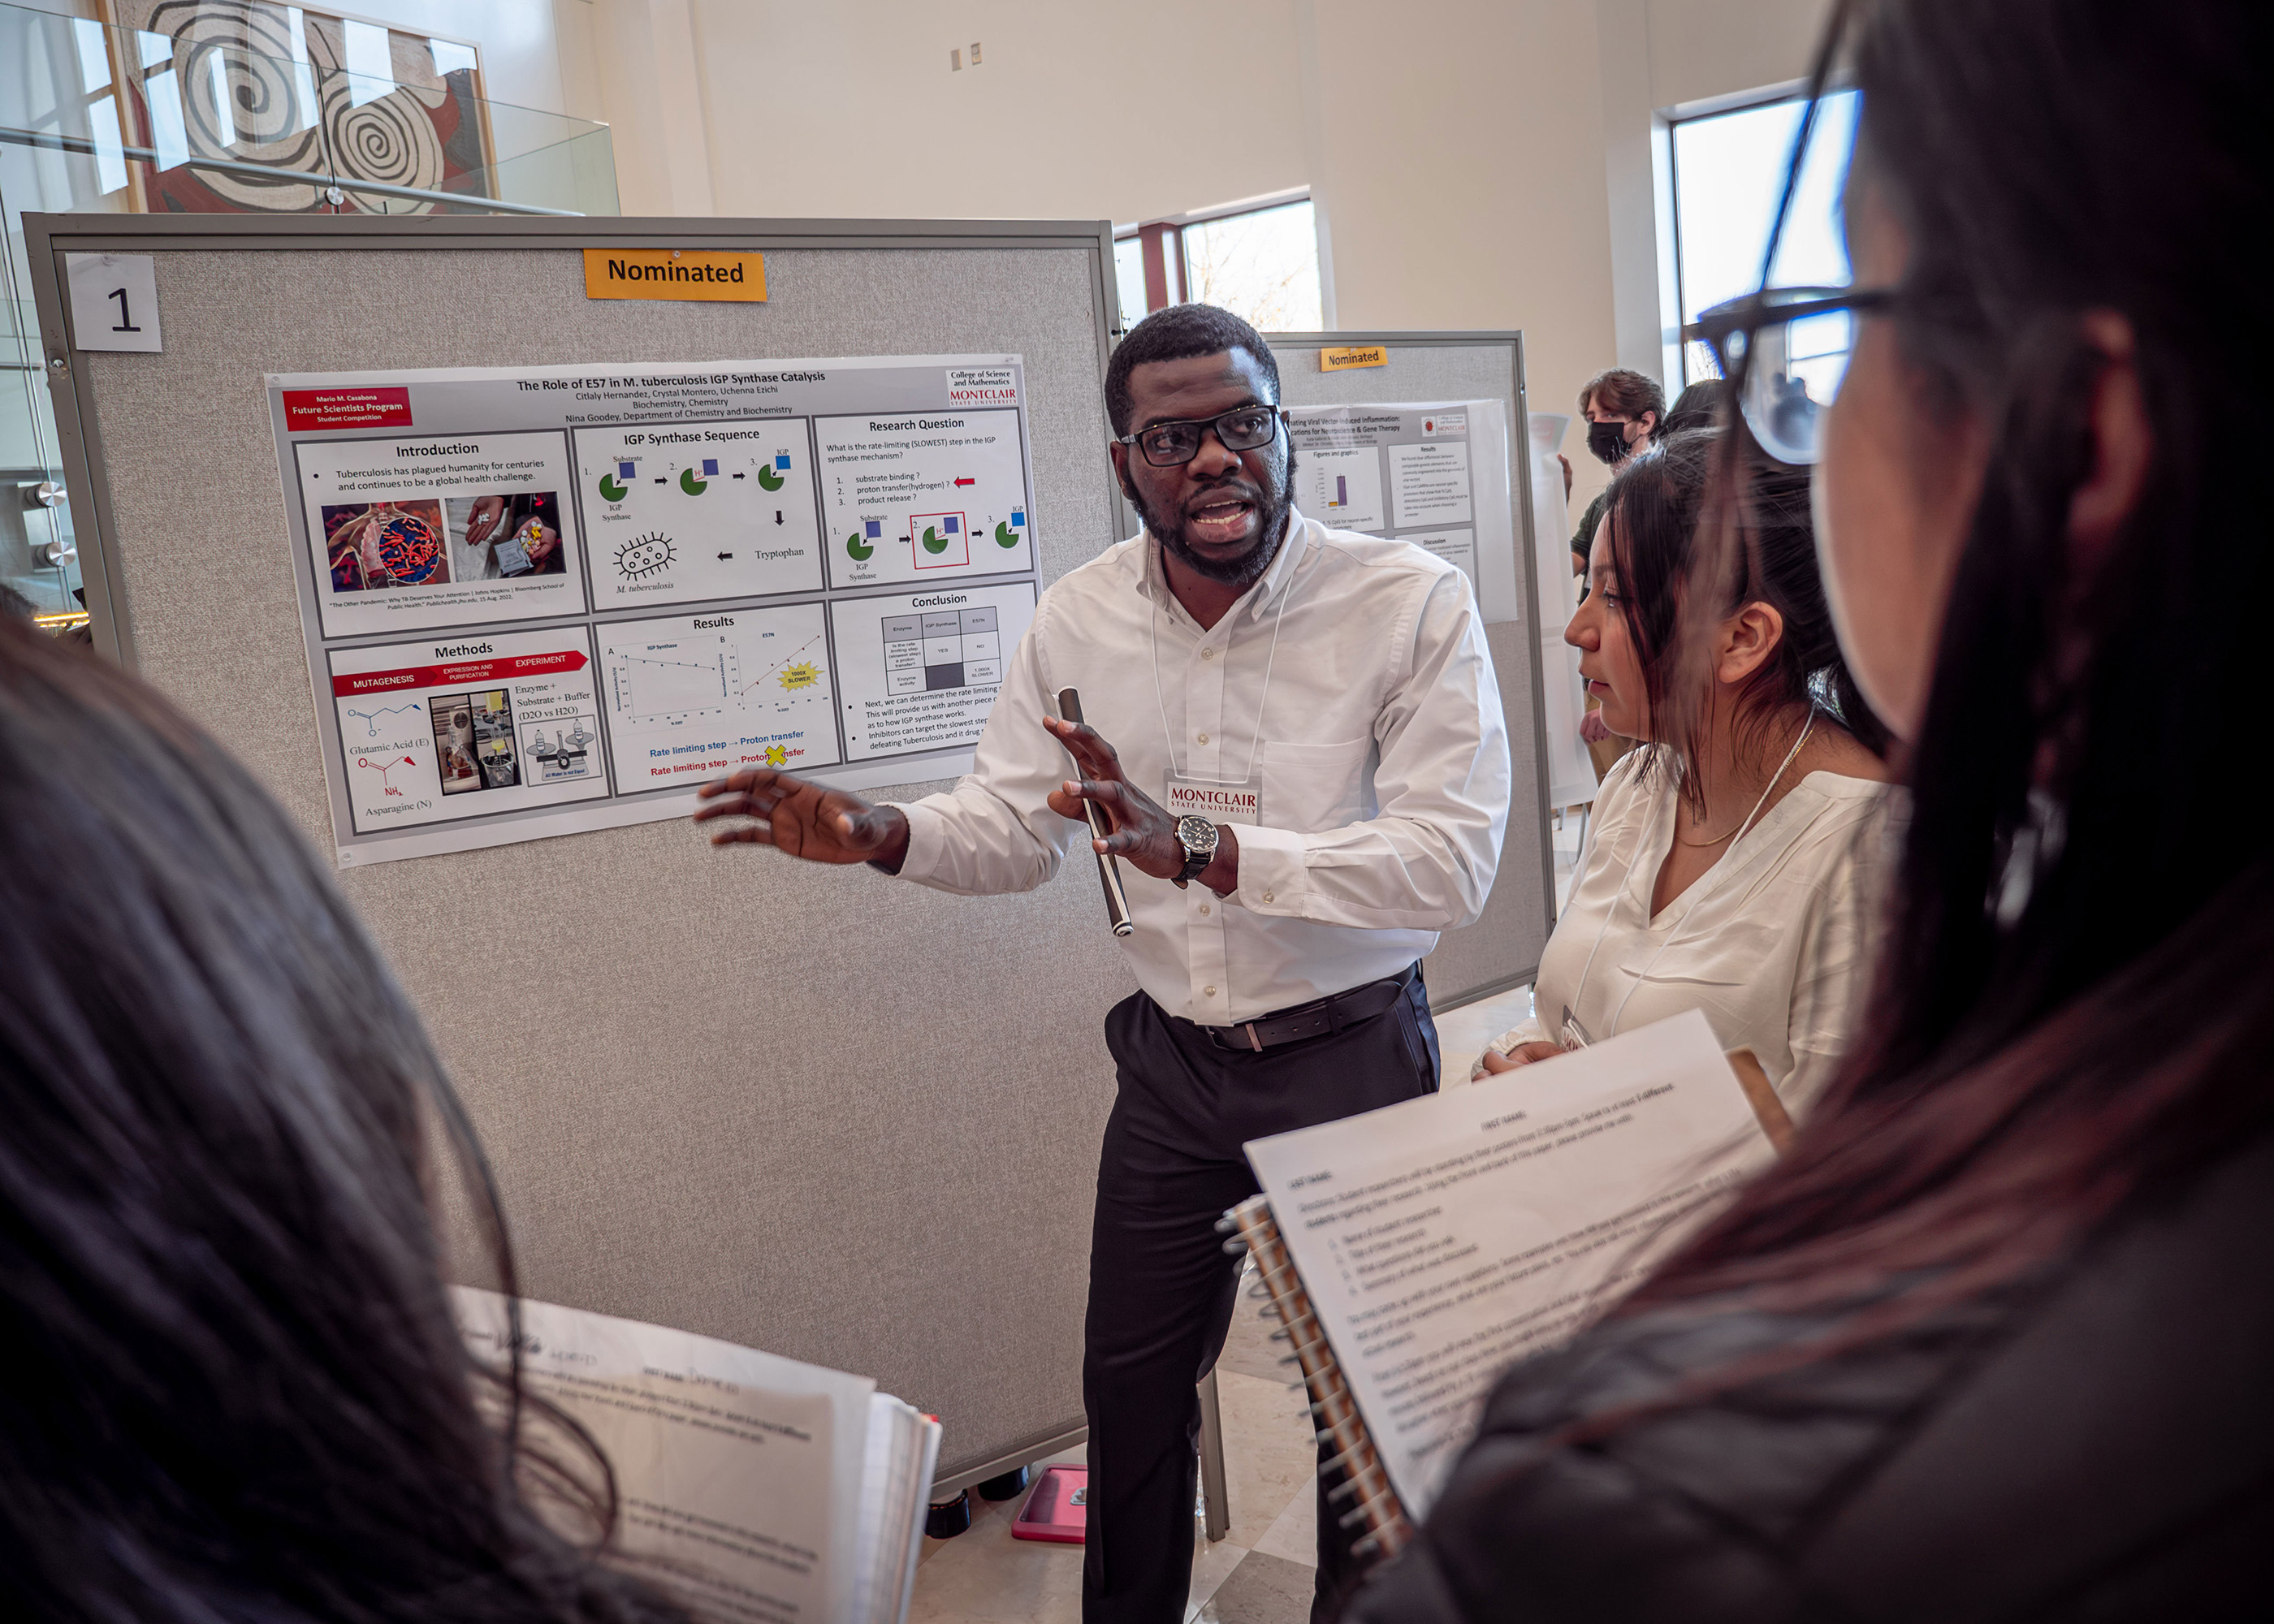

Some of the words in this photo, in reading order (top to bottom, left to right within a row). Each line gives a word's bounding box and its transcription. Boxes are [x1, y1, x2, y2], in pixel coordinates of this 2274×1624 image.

[608, 259, 744, 283] Nominated
[108, 287, 141, 332] 1
[1329, 350, 1379, 365] Nominated
[517, 380, 539, 391] The
[542, 379, 568, 390] Role
[571, 378, 582, 389] of
[586, 378, 606, 388] E57
[609, 378, 620, 387] in
[622, 378, 638, 387] M.
[641, 375, 708, 387] tuberculosis
[710, 374, 728, 384] IGP
[731, 373, 778, 385] Synthase
[780, 371, 825, 383] Catalysis
[950, 370, 976, 380] College
[953, 378, 966, 387] and
[968, 378, 1009, 386] Mathematics
[575, 391, 601, 401] Citlaly
[603, 390, 651, 400] Hernandez,
[651, 388, 680, 399] Crystal
[681, 388, 719, 397] Montero,
[720, 387, 754, 395] Uchenna
[756, 385, 778, 394] Ezichi
[950, 388, 1016, 400] MONTCLAIR
[292, 406, 322, 414] Future
[323, 404, 365, 413] Scientists
[365, 403, 403, 412] Program
[632, 400, 687, 410] Biochemistry,
[688, 398, 728, 407] Chemistry
[343, 413, 382, 421] Competition
[565, 414, 585, 422] Nina
[586, 412, 621, 423] Goodey,
[623, 411, 672, 421] Department
[674, 409, 682, 417] of
[684, 409, 724, 417] Chemistry
[726, 408, 741, 416] and
[742, 406, 792, 415] Biochemistry
[869, 419, 916, 432] Research
[919, 417, 965, 430] Question
[624, 434, 645, 445] IGP
[648, 431, 702, 446] Synthase
[704, 430, 759, 443] Sequence
[826, 443, 846, 451] What
[854, 443, 867, 451] the
[867, 441, 910, 450] rate-limiting
[910, 438, 948, 449] (SLOWEST)
[949, 438, 963, 447] step
[396, 443, 479, 457] Introduction
[827, 454, 858, 464] synthase
[860, 451, 903, 460] mechanism?
[335, 468, 392, 478] Tuberculosis
[393, 467, 409, 475] has
[411, 464, 447, 476] plagued
[447, 463, 489, 472] humanity
[491, 461, 504, 469] for
[505, 460, 545, 469] centuries
[338, 482, 356, 490] and
[357, 481, 401, 490] continues
[403, 479, 413, 487] to
[414, 477, 426, 486] be
[435, 475, 462, 487] global
[463, 473, 491, 483] health
[493, 473, 536, 482] challenge.
[855, 474, 888, 483] substrate
[888, 473, 914, 481] binding
[856, 486, 880, 495] proton
[881, 481, 945, 492] transfer(hydrogen)
[858, 496, 885, 506] product
[886, 495, 911, 503] release
[754, 547, 804, 560] Tryptophan
[911, 594, 967, 607] Conclusion
[693, 616, 734, 629] Results
[434, 642, 493, 658] Methods
[515, 654, 566, 667] EXPERIMENT
[352, 675, 414, 689] MUTAGENESIS
[515, 685, 548, 694] Enzyme
[517, 697, 555, 706] Substrate
[564, 691, 590, 702] Buffer
[864, 700, 884, 709] Next,
[910, 693, 945, 702] determine
[972, 686, 997, 694] limiting
[518, 710, 543, 721] (D2O
[555, 706, 578, 716] H2O)
[866, 710, 880, 719] This
[881, 708, 893, 716] will
[894, 705, 920, 716] provide
[930, 702, 946, 710] with
[947, 699, 973, 708] another
[974, 697, 991, 706] piece
[901, 716, 914, 724] IGP
[914, 714, 944, 723] synthase
[945, 710, 966, 718] works.
[868, 729, 901, 739] Inhibitors
[914, 724, 936, 733] target
[949, 719, 974, 728] slowest
[349, 743, 390, 755] Glutamic
[392, 739, 413, 749] Acid
[415, 738, 430, 748] (E)
[650, 749, 670, 758] Rate
[672, 744, 706, 754] limiting
[707, 741, 727, 749] step
[740, 736, 769, 745] Proton
[771, 730, 804, 741] transfer
[869, 740, 902, 749] defeating
[902, 734, 944, 745] Tuberculosis
[945, 731, 958, 739] and
[650, 767, 671, 776] Rate
[672, 762, 707, 773] limiting
[707, 759, 728, 768] step
[741, 754, 770, 763] Proton
[1171, 788, 1256, 807] MONTCLAIR
[365, 802, 414, 816] Asparagine
[416, 799, 432, 810] (N)
[1171, 801, 1195, 809] STATE
[1200, 804, 1256, 814] UNIVERSITY
